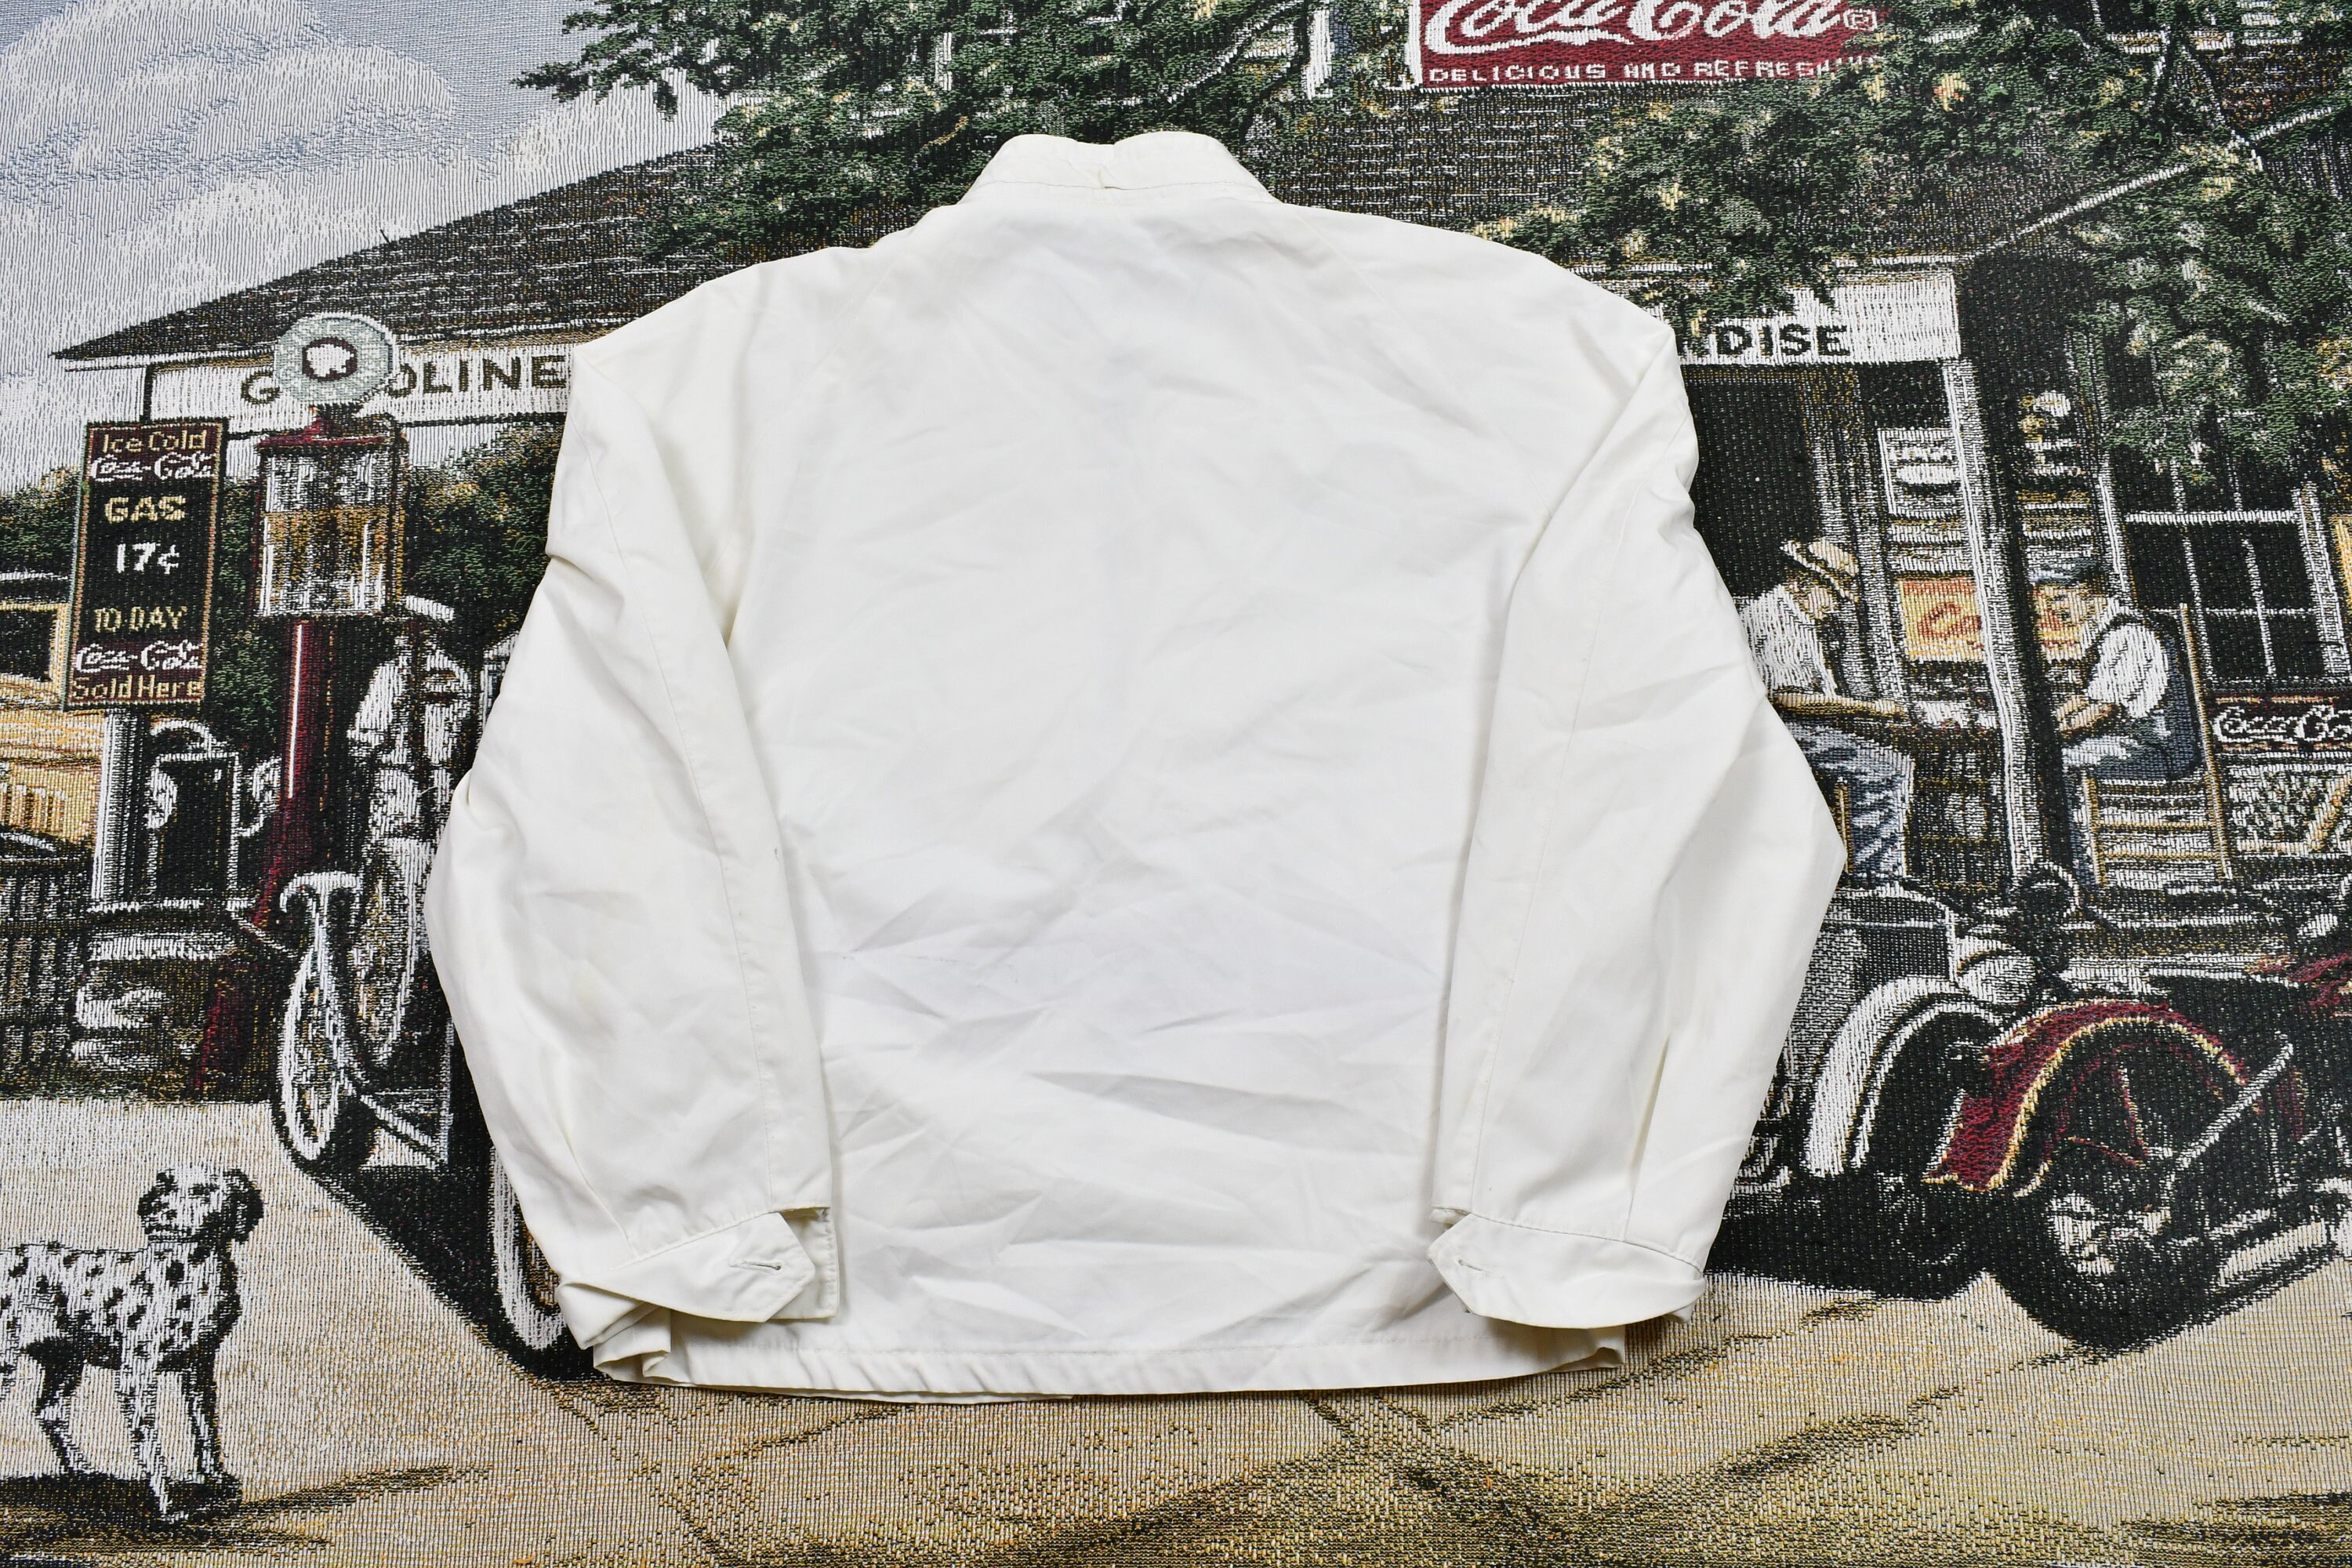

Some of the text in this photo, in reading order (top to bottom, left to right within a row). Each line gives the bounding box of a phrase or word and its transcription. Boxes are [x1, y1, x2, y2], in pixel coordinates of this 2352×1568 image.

[1428, 64, 1606, 82] DELICIOUS
[1693, 56, 1883, 78] REFRESH
[1678, 323, 1851, 358] DISE
[241, 354, 567, 405] GOLINE
[102, 430, 207, 453] Ice Cold
[104, 495, 186, 524] GAS
[116, 542, 180, 575] 17¢
[72, 674, 204, 699] Sold Here
